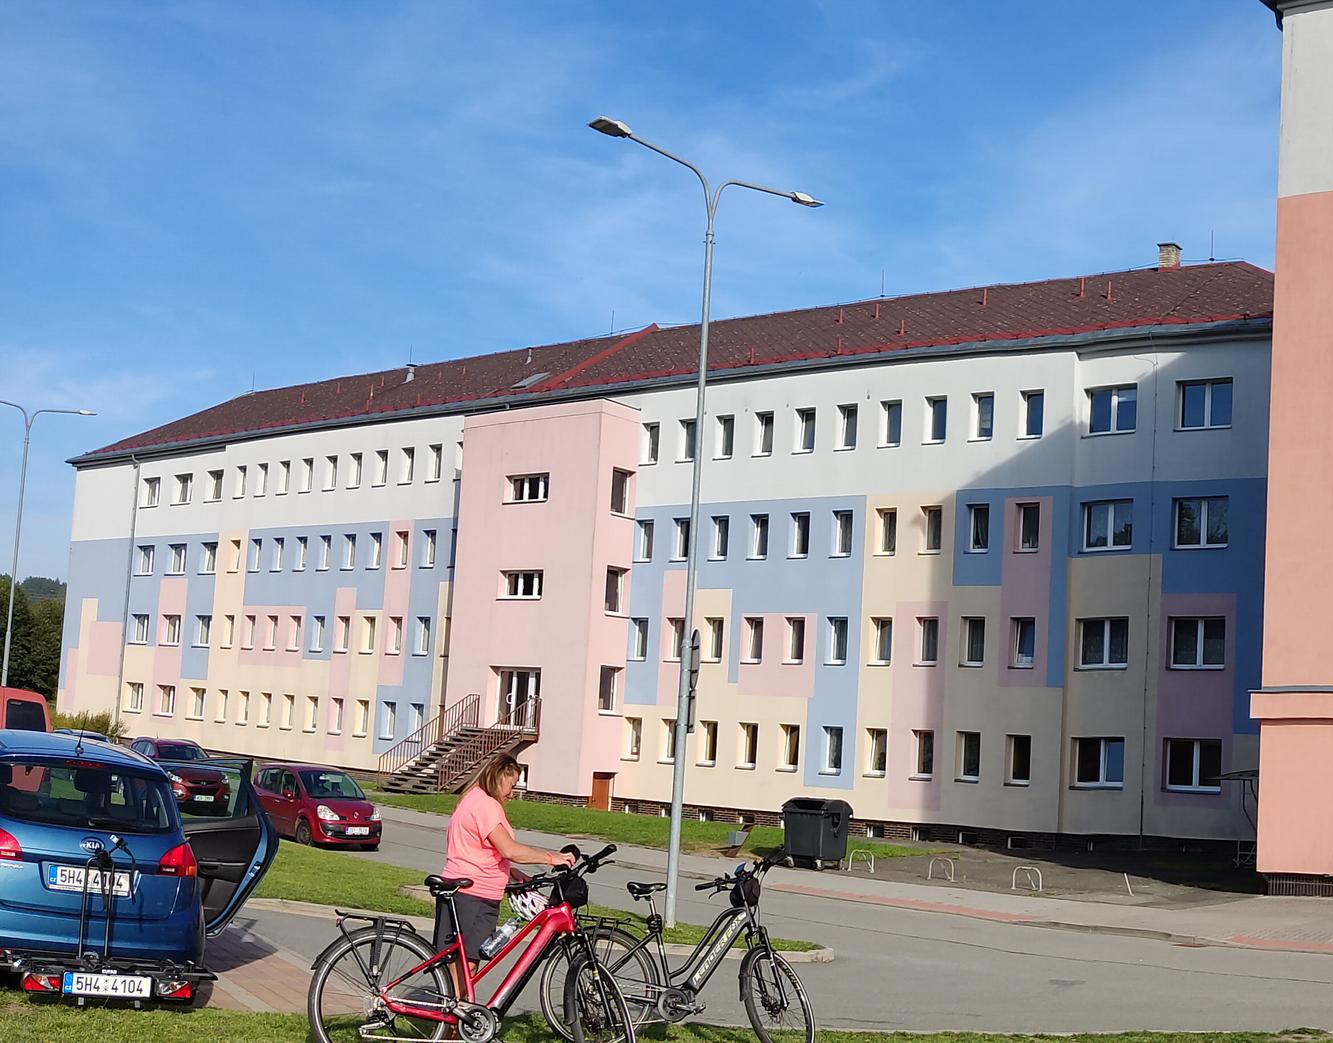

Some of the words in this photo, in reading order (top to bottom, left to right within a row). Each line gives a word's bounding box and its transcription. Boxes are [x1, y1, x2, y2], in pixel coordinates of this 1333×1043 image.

[86, 841, 100, 850] KIA
[60, 869, 83, 884] 5H4
[76, 976, 100, 992] 5H4
[111, 978, 143, 994] 4104
